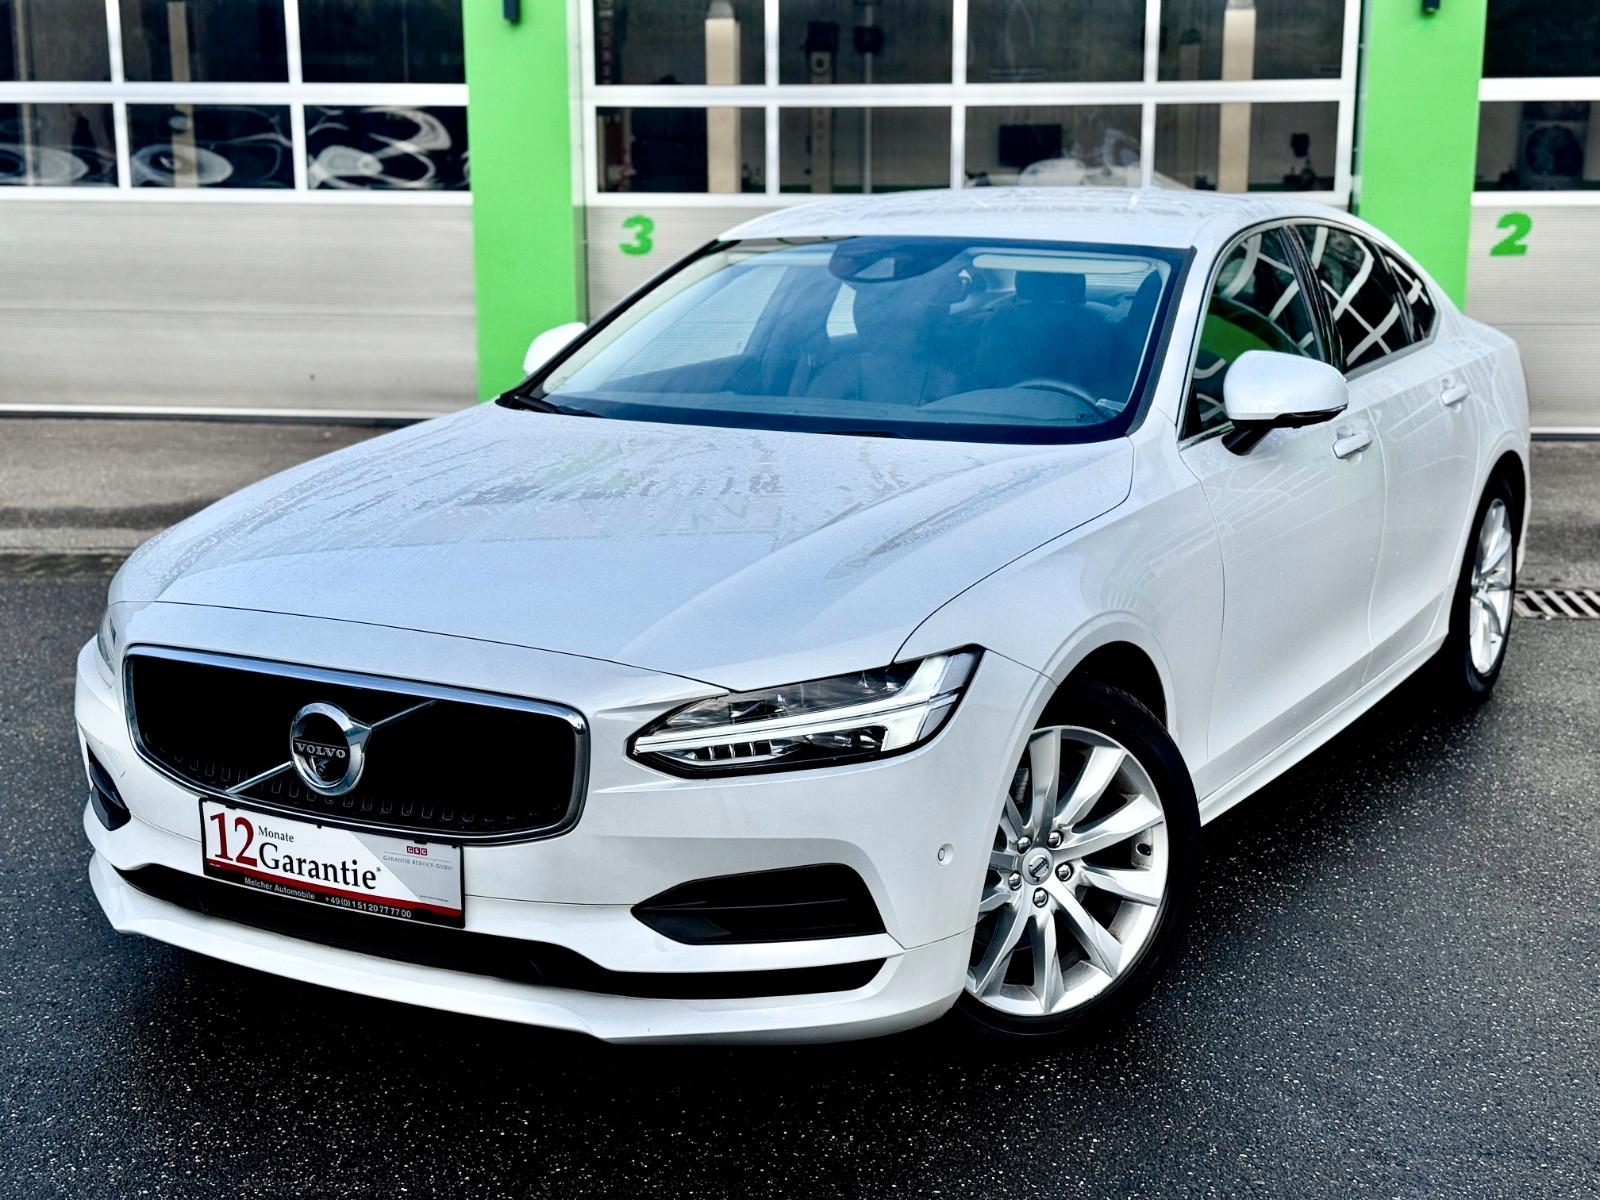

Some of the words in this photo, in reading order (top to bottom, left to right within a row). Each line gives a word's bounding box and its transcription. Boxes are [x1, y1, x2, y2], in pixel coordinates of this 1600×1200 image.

[619, 214, 654, 256] 3
[1490, 212, 1532, 256] 2
[295, 742, 346, 758] VOLVO
[209, 812, 258, 868] 12
[258, 825, 295, 843] Monate
[244, 876, 273, 891] Melcher
[274, 884, 316, 900] Automobile
